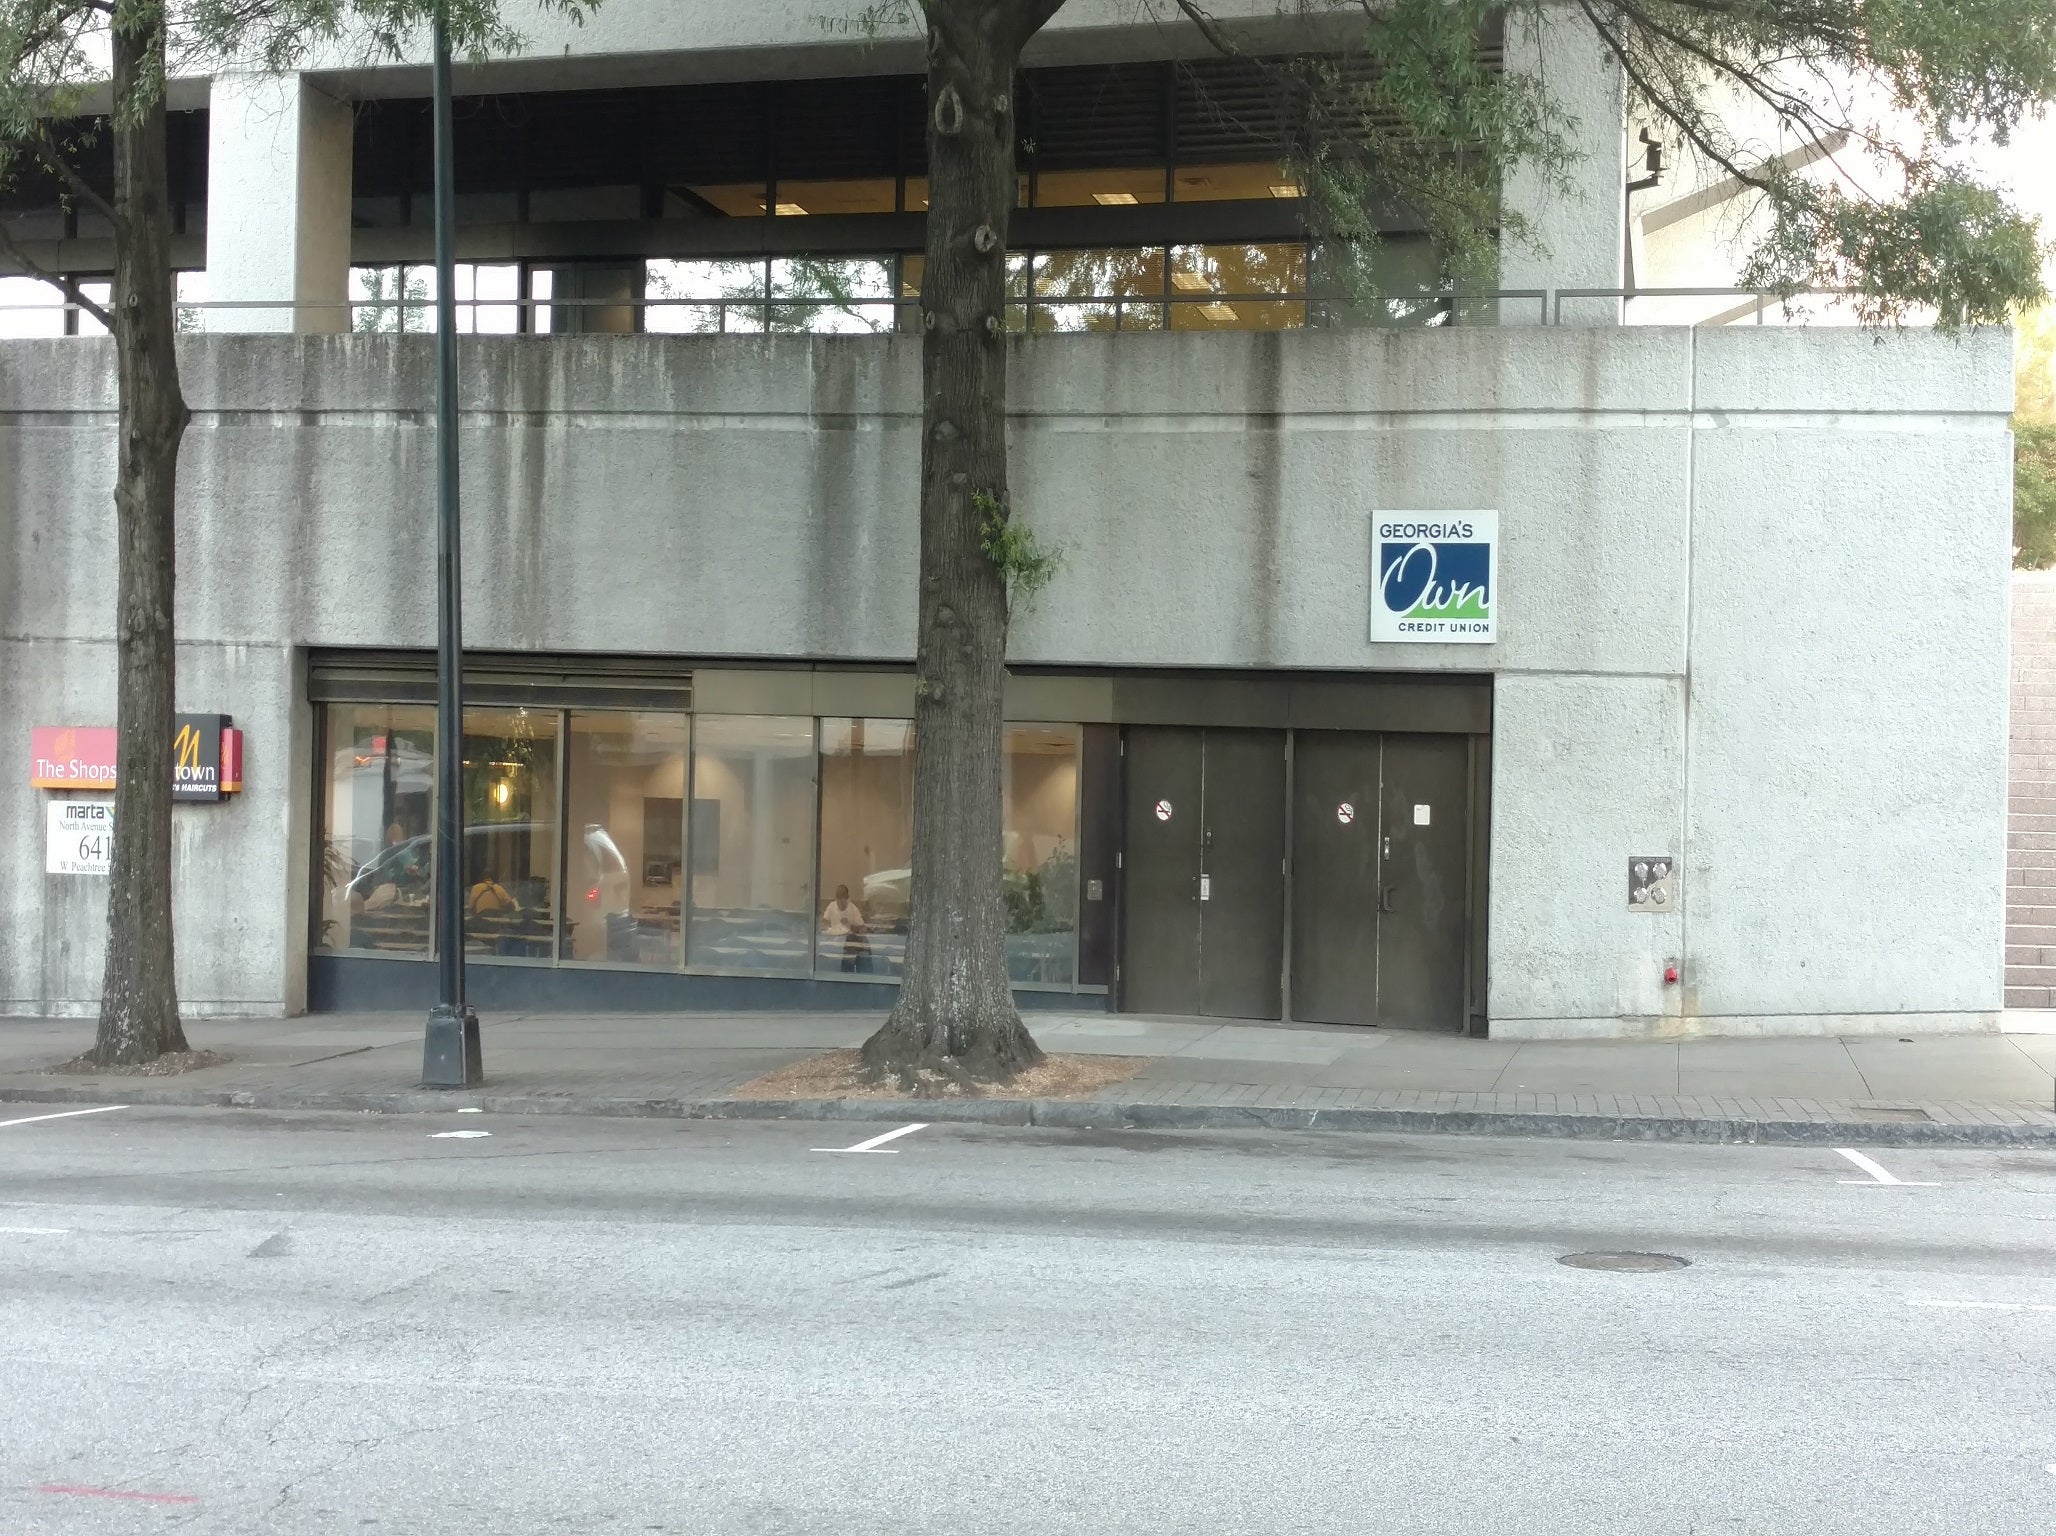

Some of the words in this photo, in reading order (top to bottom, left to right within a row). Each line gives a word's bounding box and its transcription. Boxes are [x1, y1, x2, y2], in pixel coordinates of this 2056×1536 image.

[1380, 520, 1473, 539] GEORGIA'S
[1380, 542, 1490, 618] Own
[1398, 623, 1445, 632] CREDIT
[1450, 623, 1490, 633] UNION
[36, 759, 64, 778] The
[69, 759, 117, 783] Shops
[181, 784, 217, 792] HAIRCUTS
[66, 804, 104, 819] marta
[59, 820, 79, 831] North
[80, 822, 107, 831] Avenue
[79, 835, 111, 860] 641
[60, 861, 68, 871] W
[71, 862, 106, 872] Peachtree
